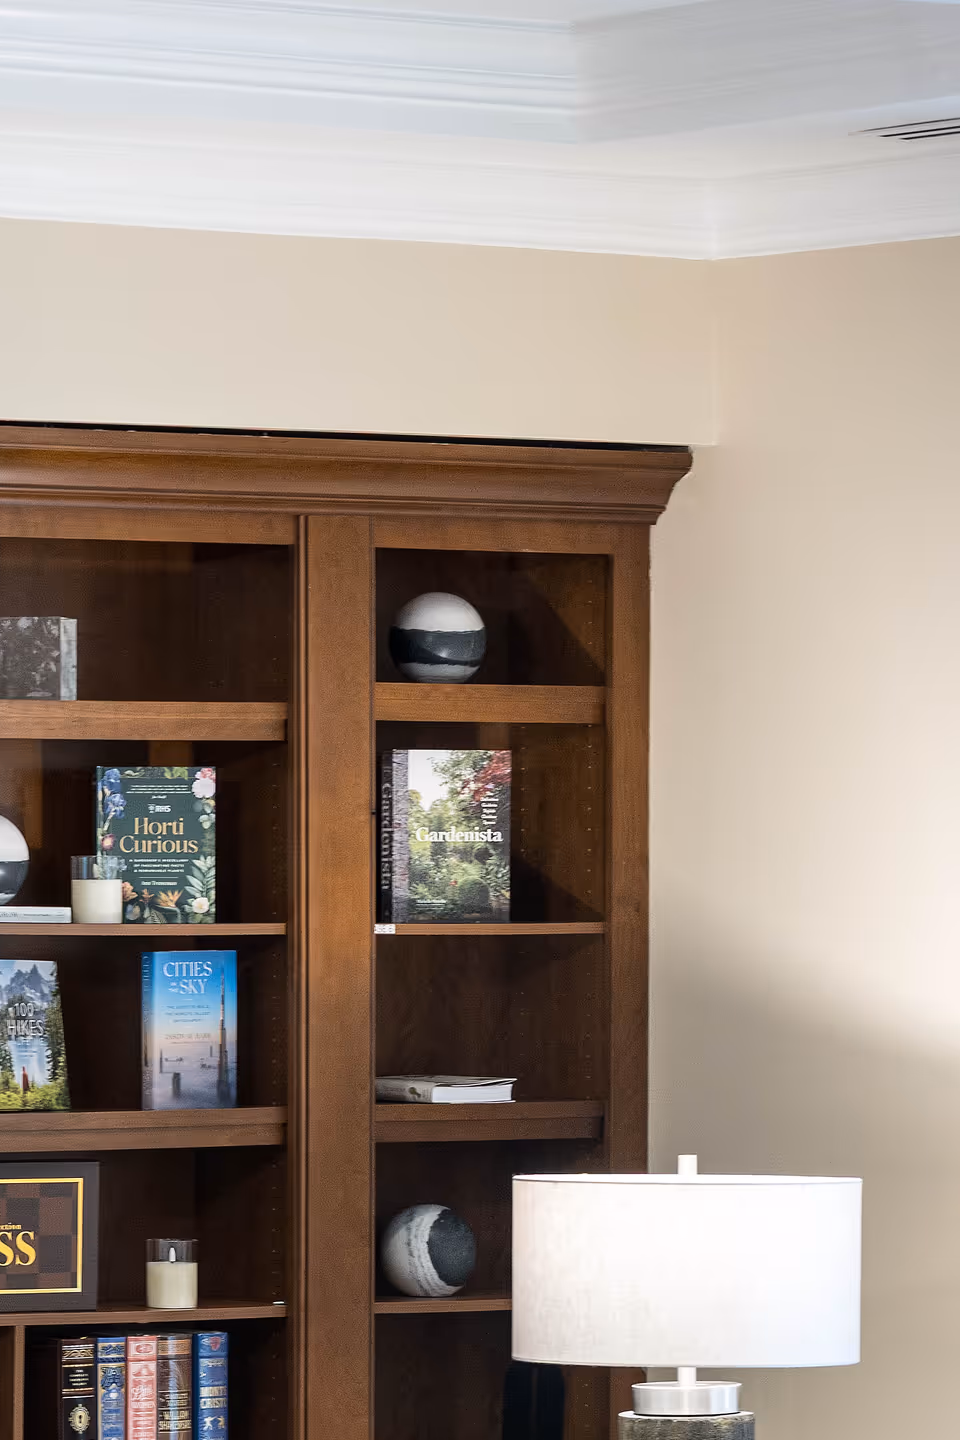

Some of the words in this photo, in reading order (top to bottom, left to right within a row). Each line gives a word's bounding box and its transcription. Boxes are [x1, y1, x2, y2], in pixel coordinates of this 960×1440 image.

[133, 817, 184, 835] Horti
[415, 826, 503, 842] Gardenista
[119, 835, 199, 853] Curious
[162, 961, 213, 977] CITIES
[179, 978, 208, 995] SKY
[13, 1002, 34, 1017] 100
[6, 1019, 44, 1036] HIKES
